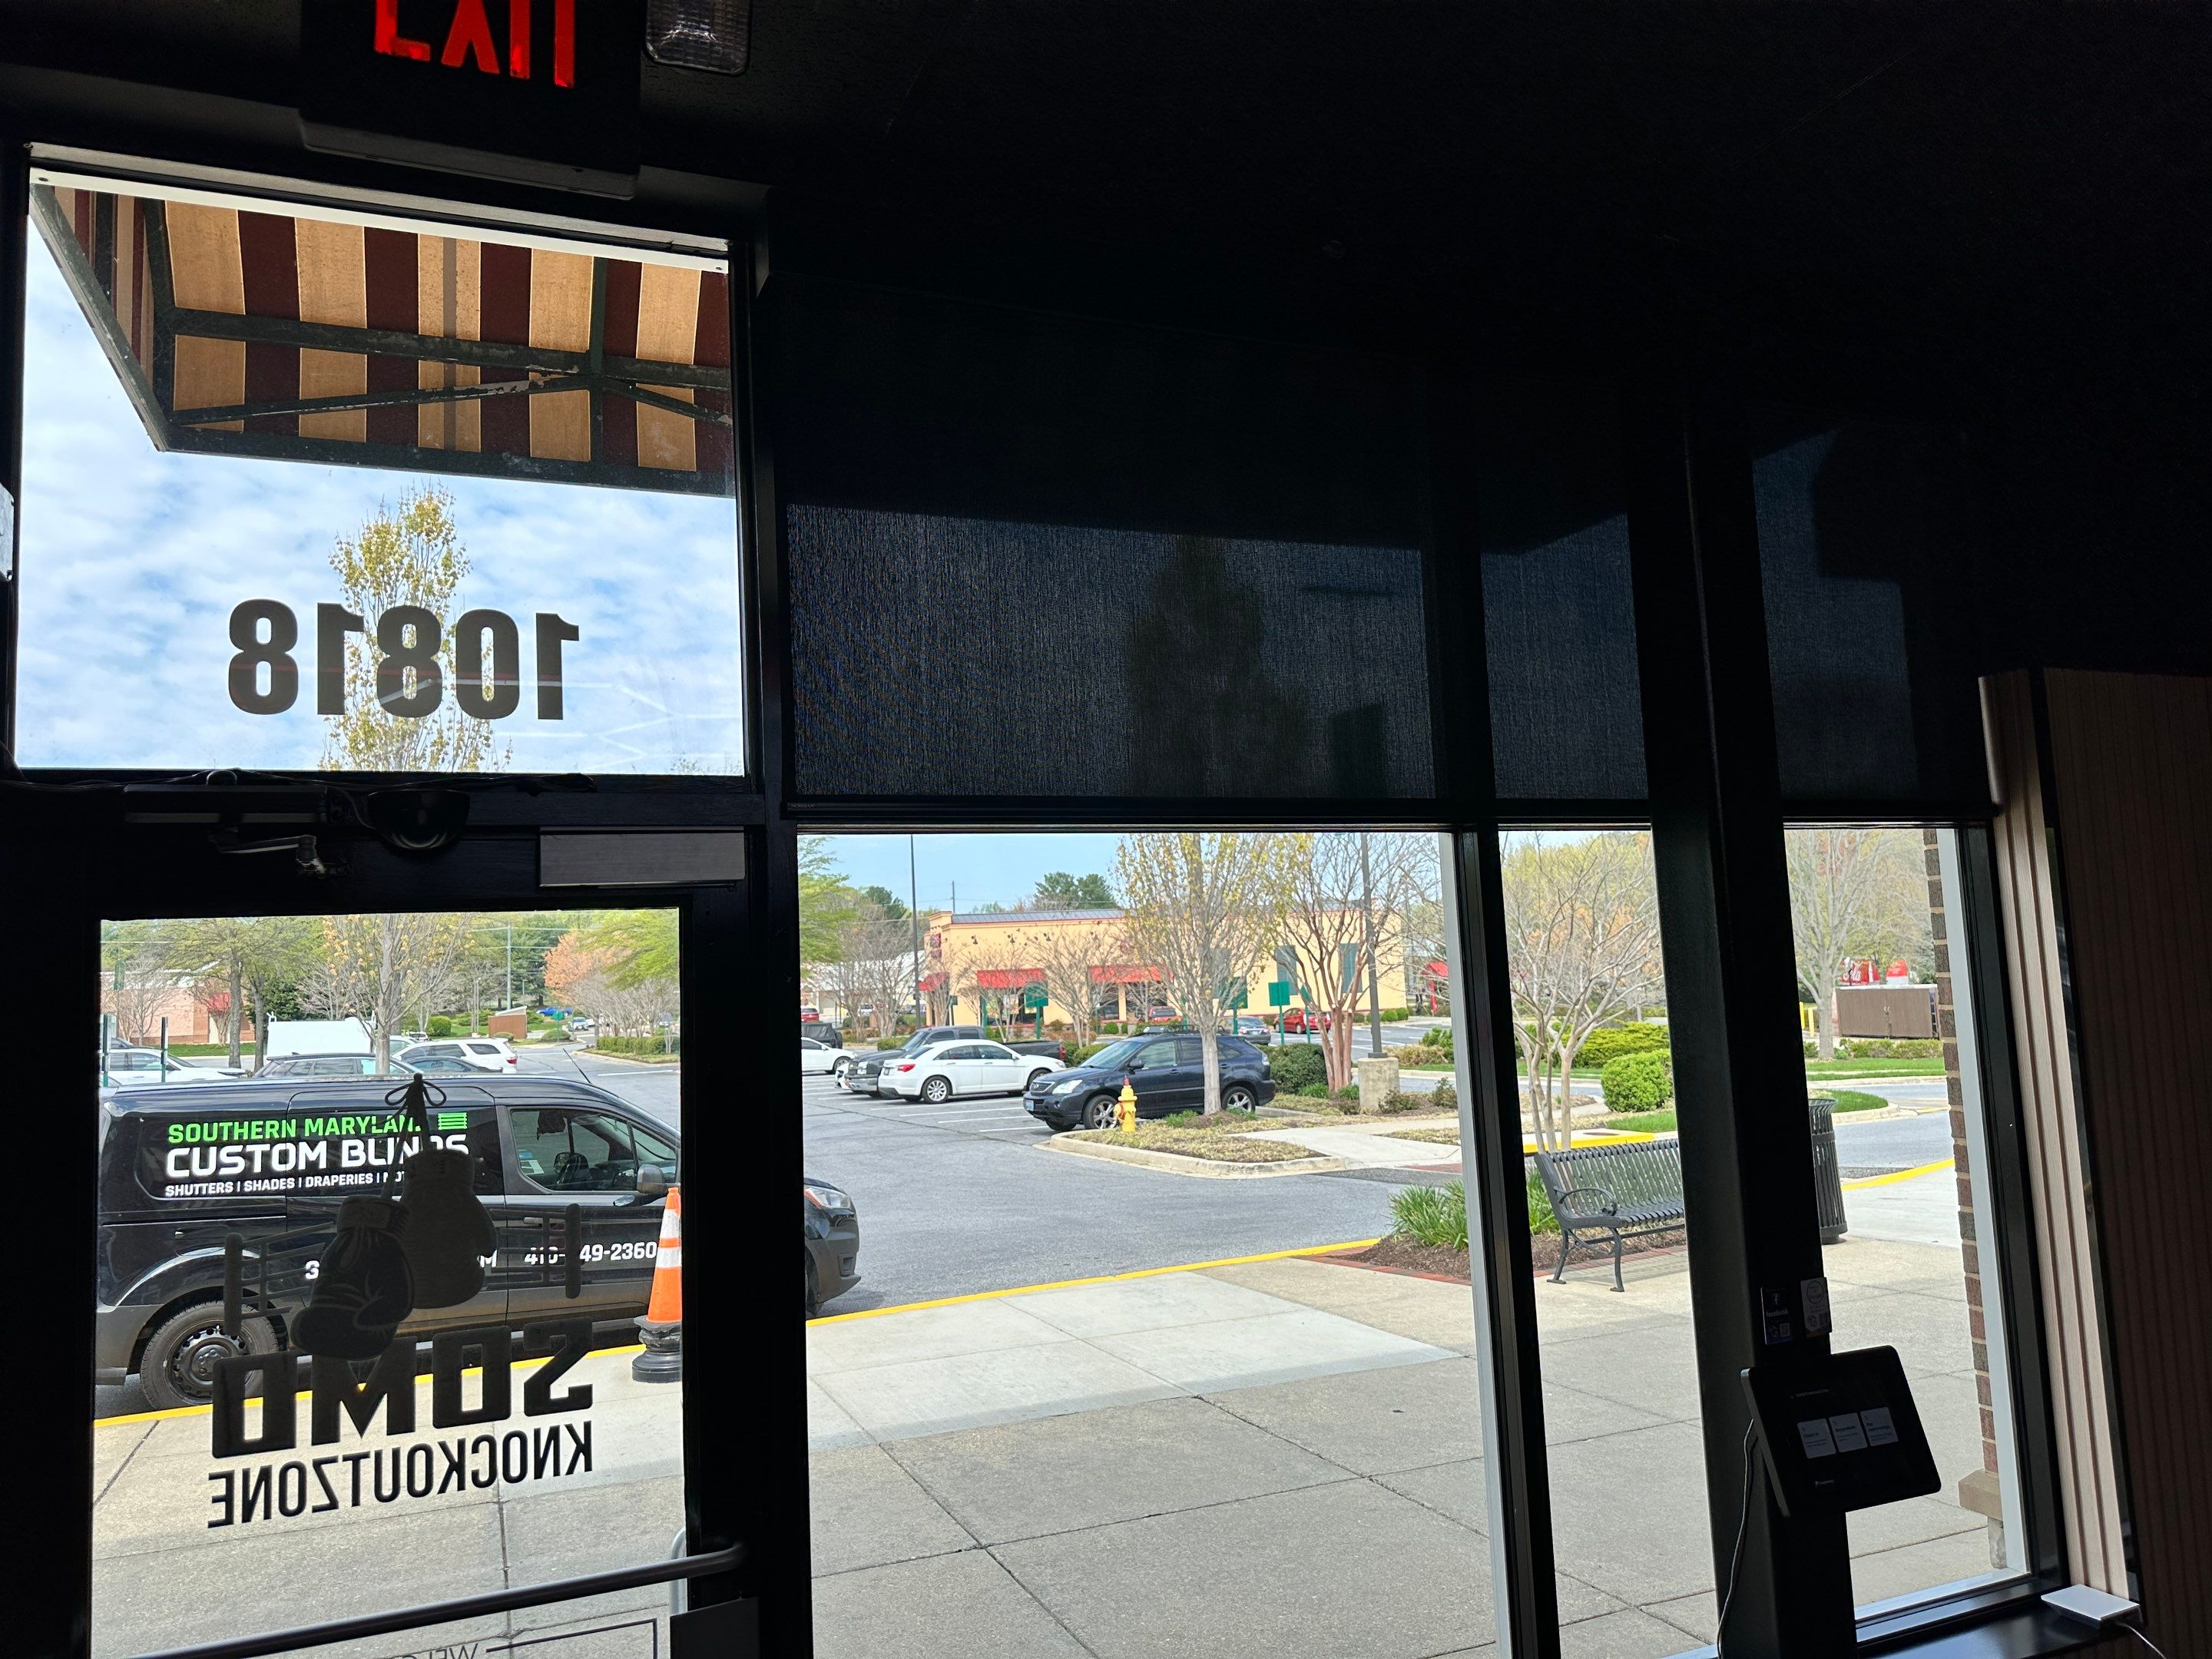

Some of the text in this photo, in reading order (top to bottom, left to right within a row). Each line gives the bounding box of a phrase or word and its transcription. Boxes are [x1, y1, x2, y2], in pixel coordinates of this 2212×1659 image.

[167, 1114, 422, 1144] SOUTHERN MARYLAN
[166, 1140, 328, 1178] CUSTOM
[164, 1181, 234, 1197] SHUTTERS
[243, 1177, 296, 1192] SHADES
[305, 1172, 374, 1187] DRAPERIES
[524, 1240, 658, 1266] 410-49-2360
